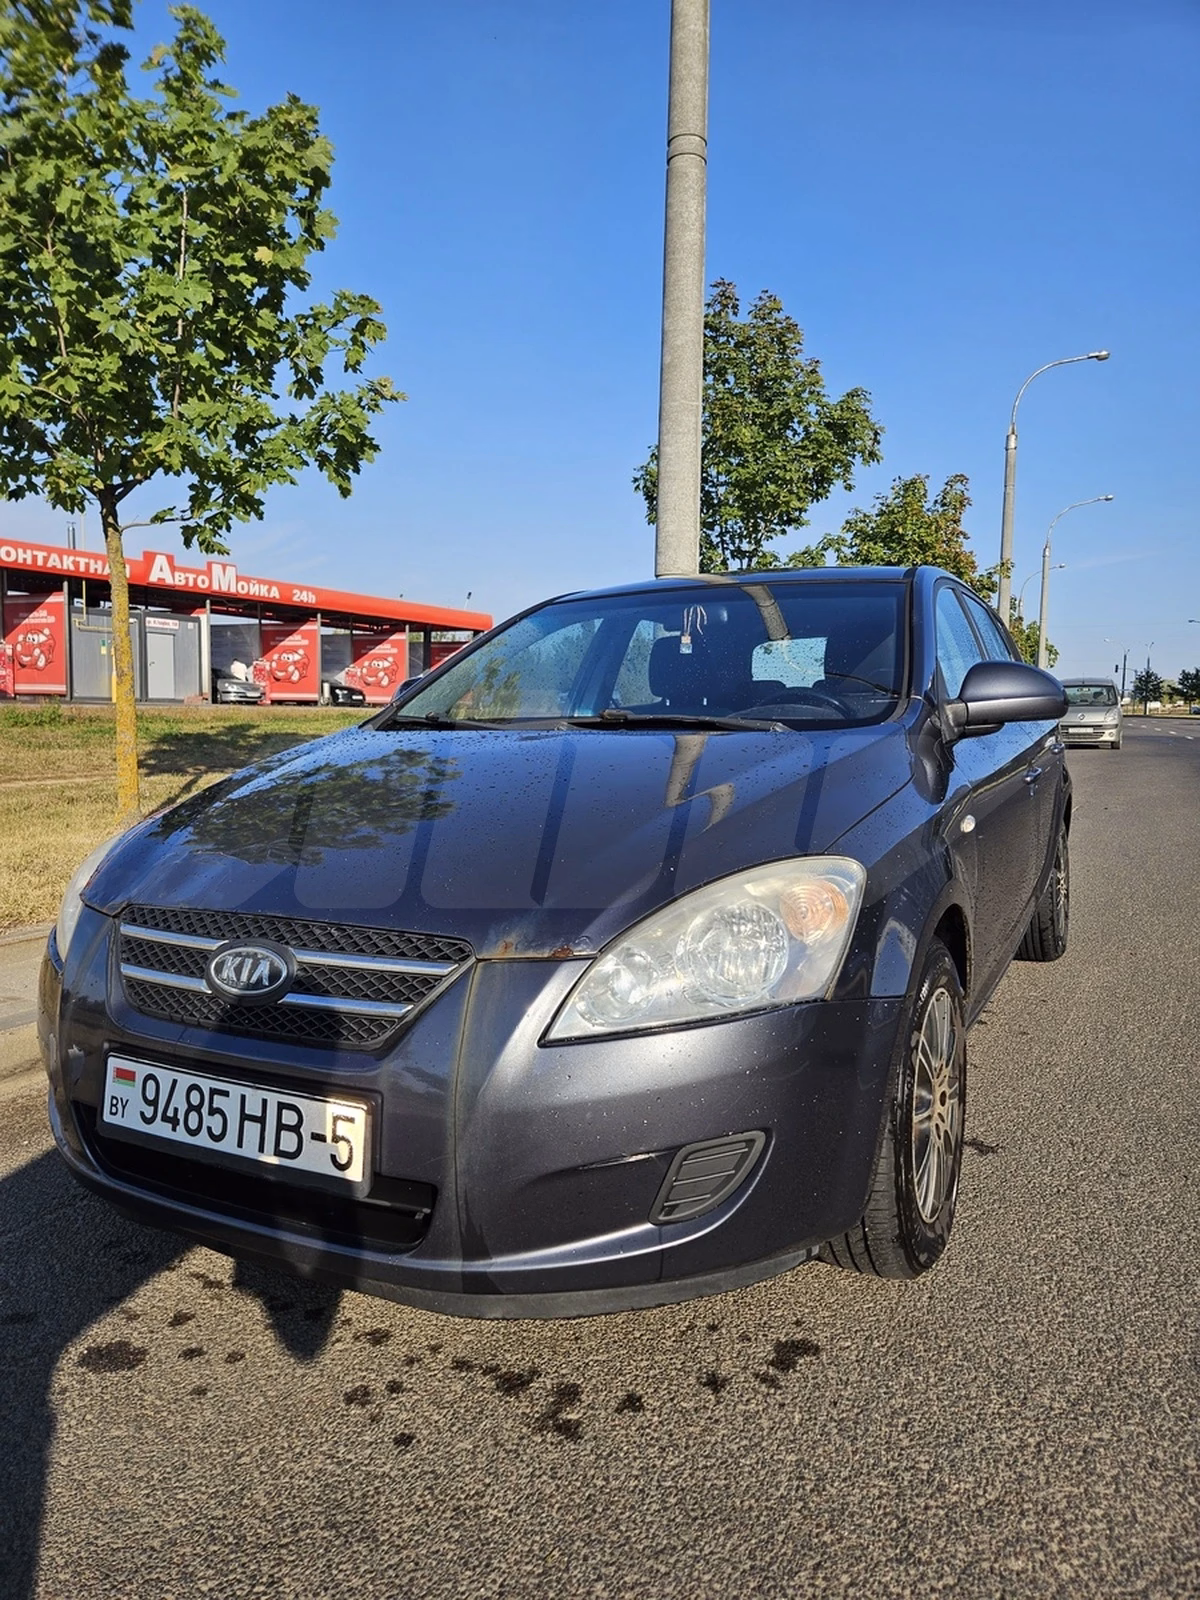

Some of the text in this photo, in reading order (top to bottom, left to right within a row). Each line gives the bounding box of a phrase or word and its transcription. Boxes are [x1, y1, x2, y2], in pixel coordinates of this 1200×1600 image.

[292, 589, 316, 604] 24h
[221, 954, 271, 987] KIA
[108, 1095, 129, 1119] BY
